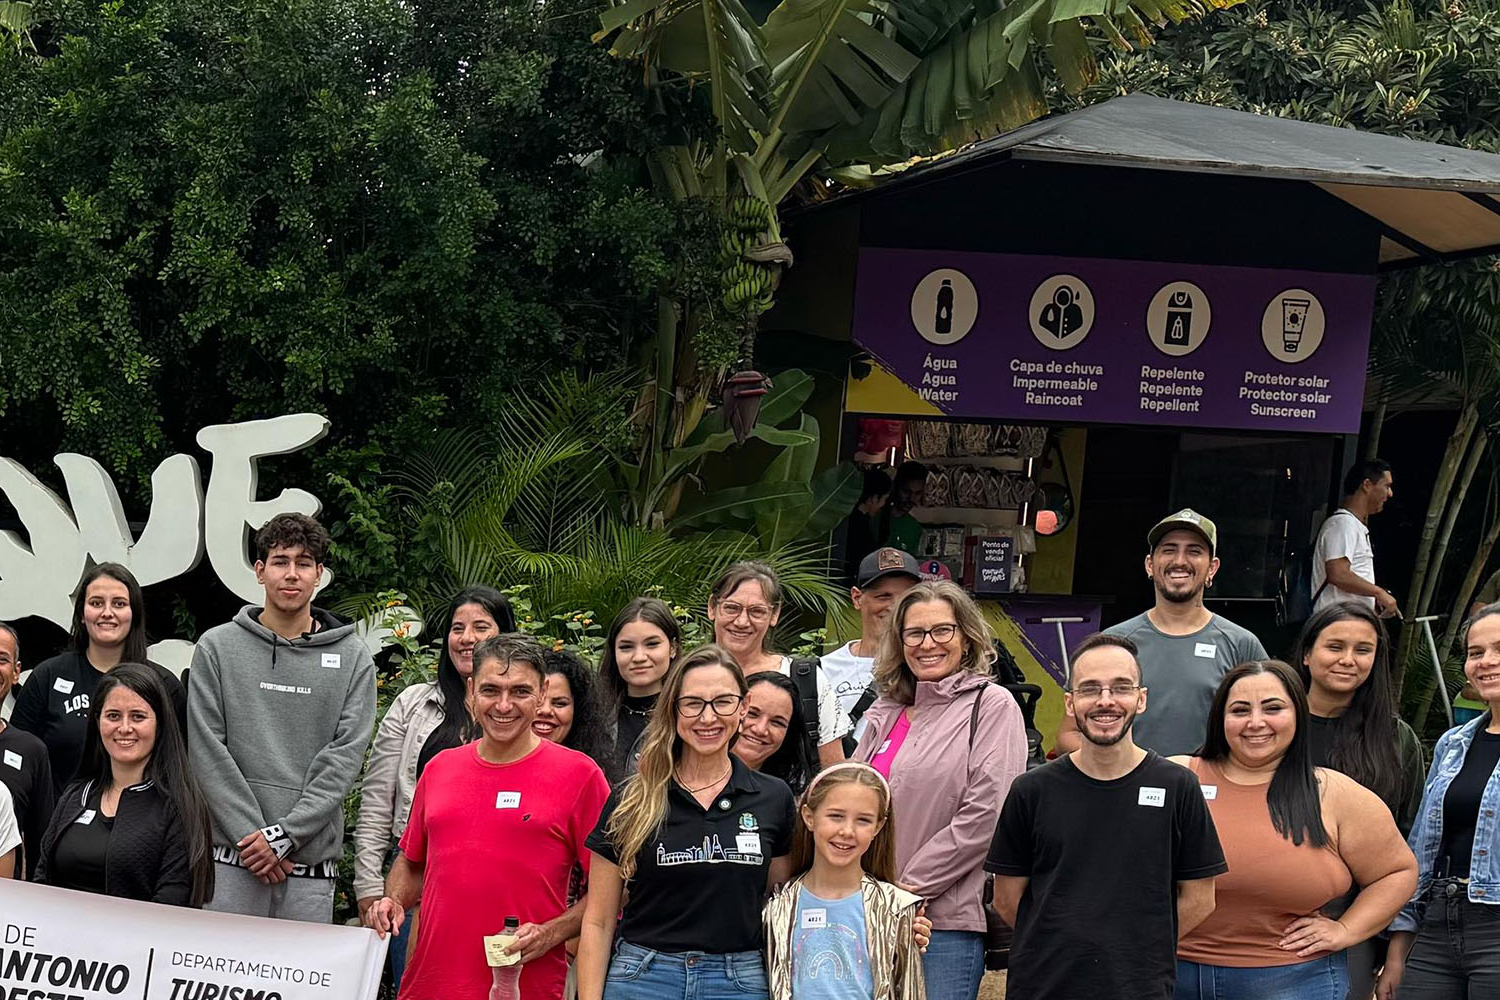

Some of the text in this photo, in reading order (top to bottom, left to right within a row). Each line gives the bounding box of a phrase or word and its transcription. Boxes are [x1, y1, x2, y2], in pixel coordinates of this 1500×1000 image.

[923, 353, 957, 370] Água
[1010, 359, 1104, 375] Capa de chuva
[922, 372, 956, 387] Agua
[1141, 365, 1205, 381] Repelente
[1244, 371, 1330, 388] Protetor solar
[1013, 375, 1098, 391] Impermeable
[1140, 381, 1203, 397] Repelente
[918, 388, 958, 401] Water
[1026, 392, 1082, 406] Raincoat
[1239, 387, 1331, 404] Protector solar
[1140, 397, 1200, 413] Repellent
[1251, 403, 1316, 419] Sunscreen
[4, 924, 37, 947] DE
[172, 951, 332, 987] DEPARTAMENTO DE
